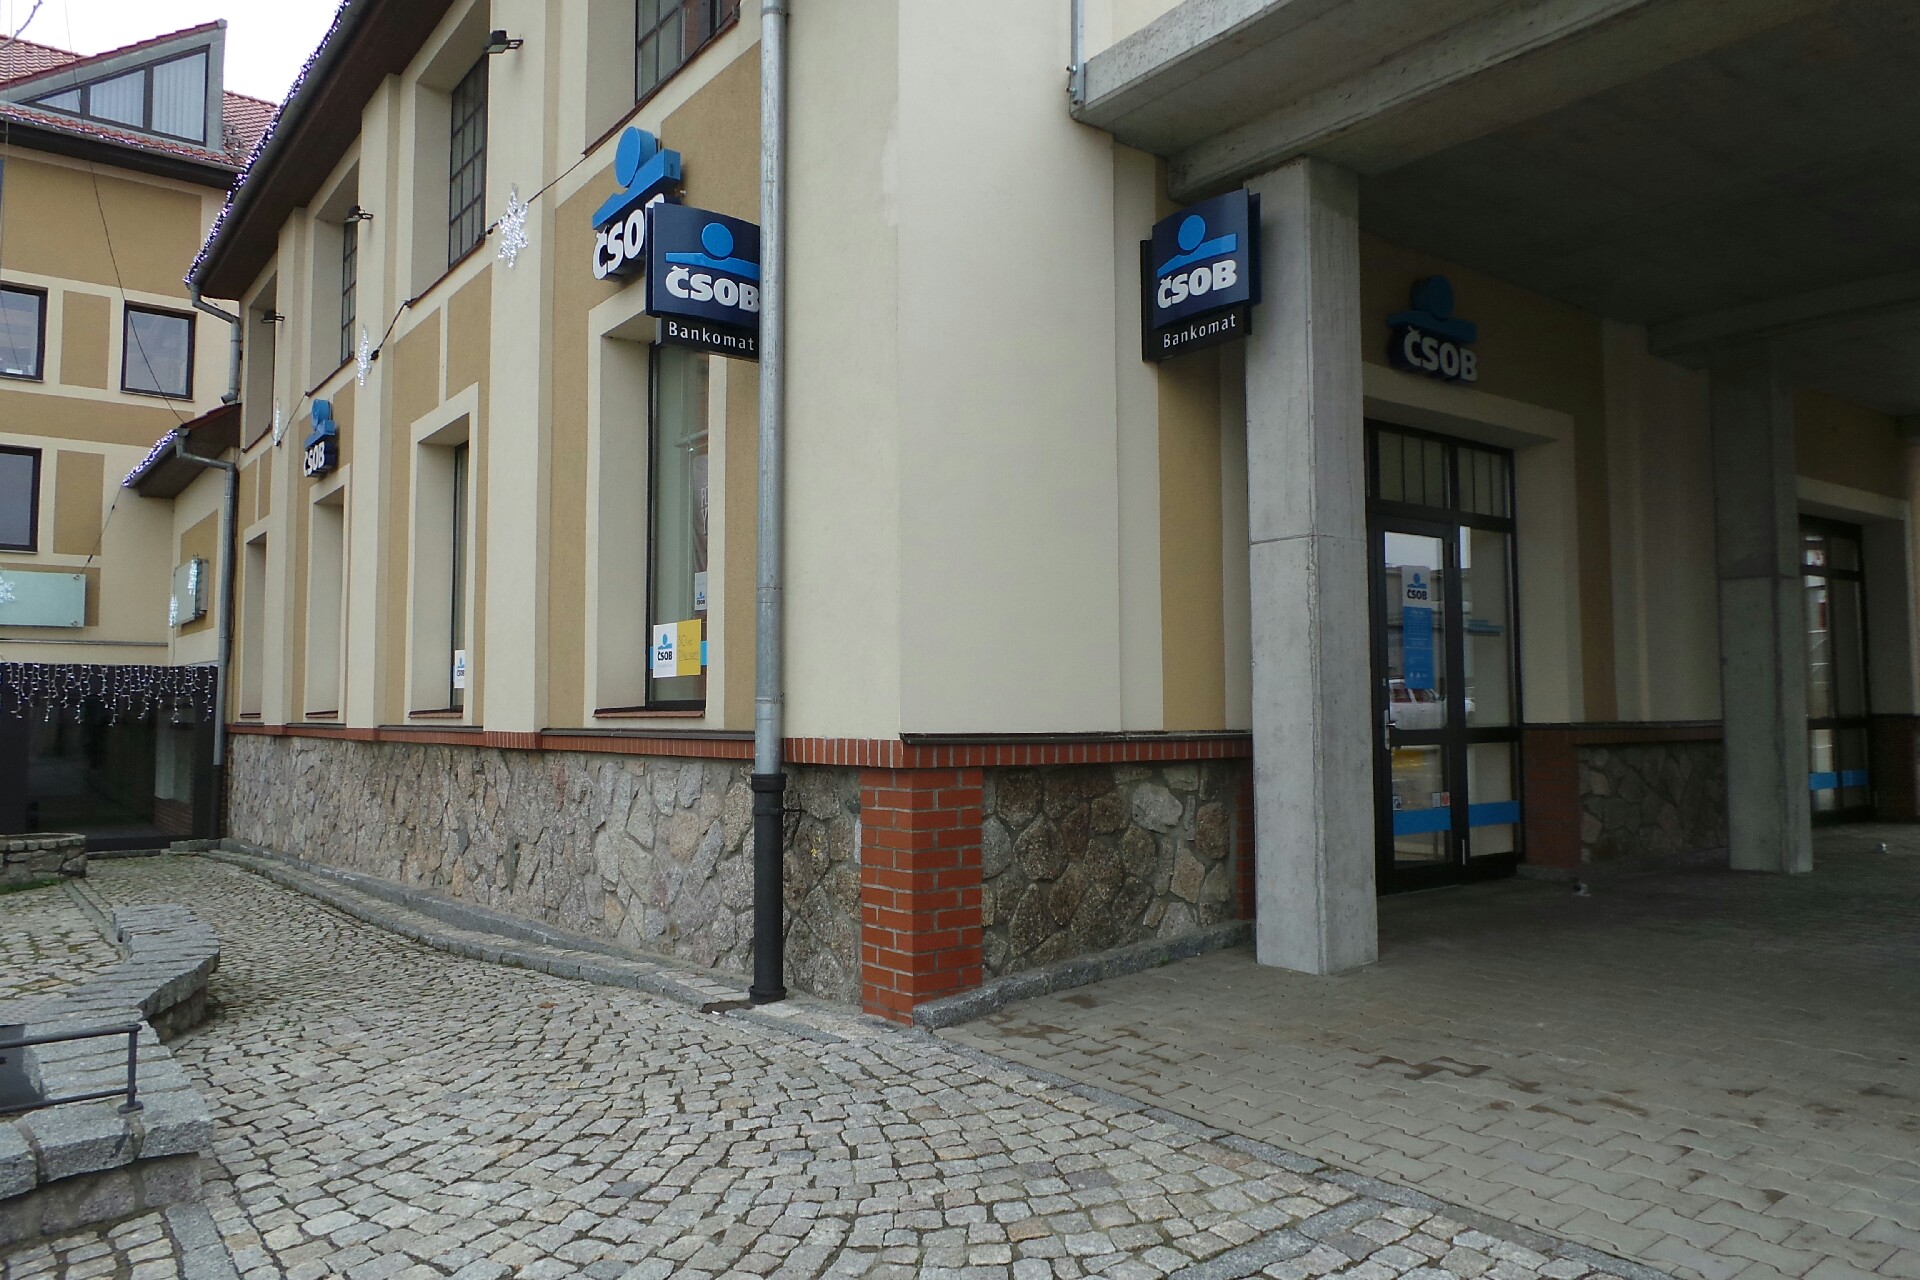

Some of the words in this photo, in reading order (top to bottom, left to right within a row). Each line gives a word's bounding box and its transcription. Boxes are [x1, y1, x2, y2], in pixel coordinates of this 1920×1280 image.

[665, 265, 759, 313] ČSOB
[1157, 259, 1237, 309] ČSOB
[668, 321, 755, 351] Bankomat
[1163, 313, 1236, 349] Bankomat
[1404, 325, 1478, 382] ČSOB
